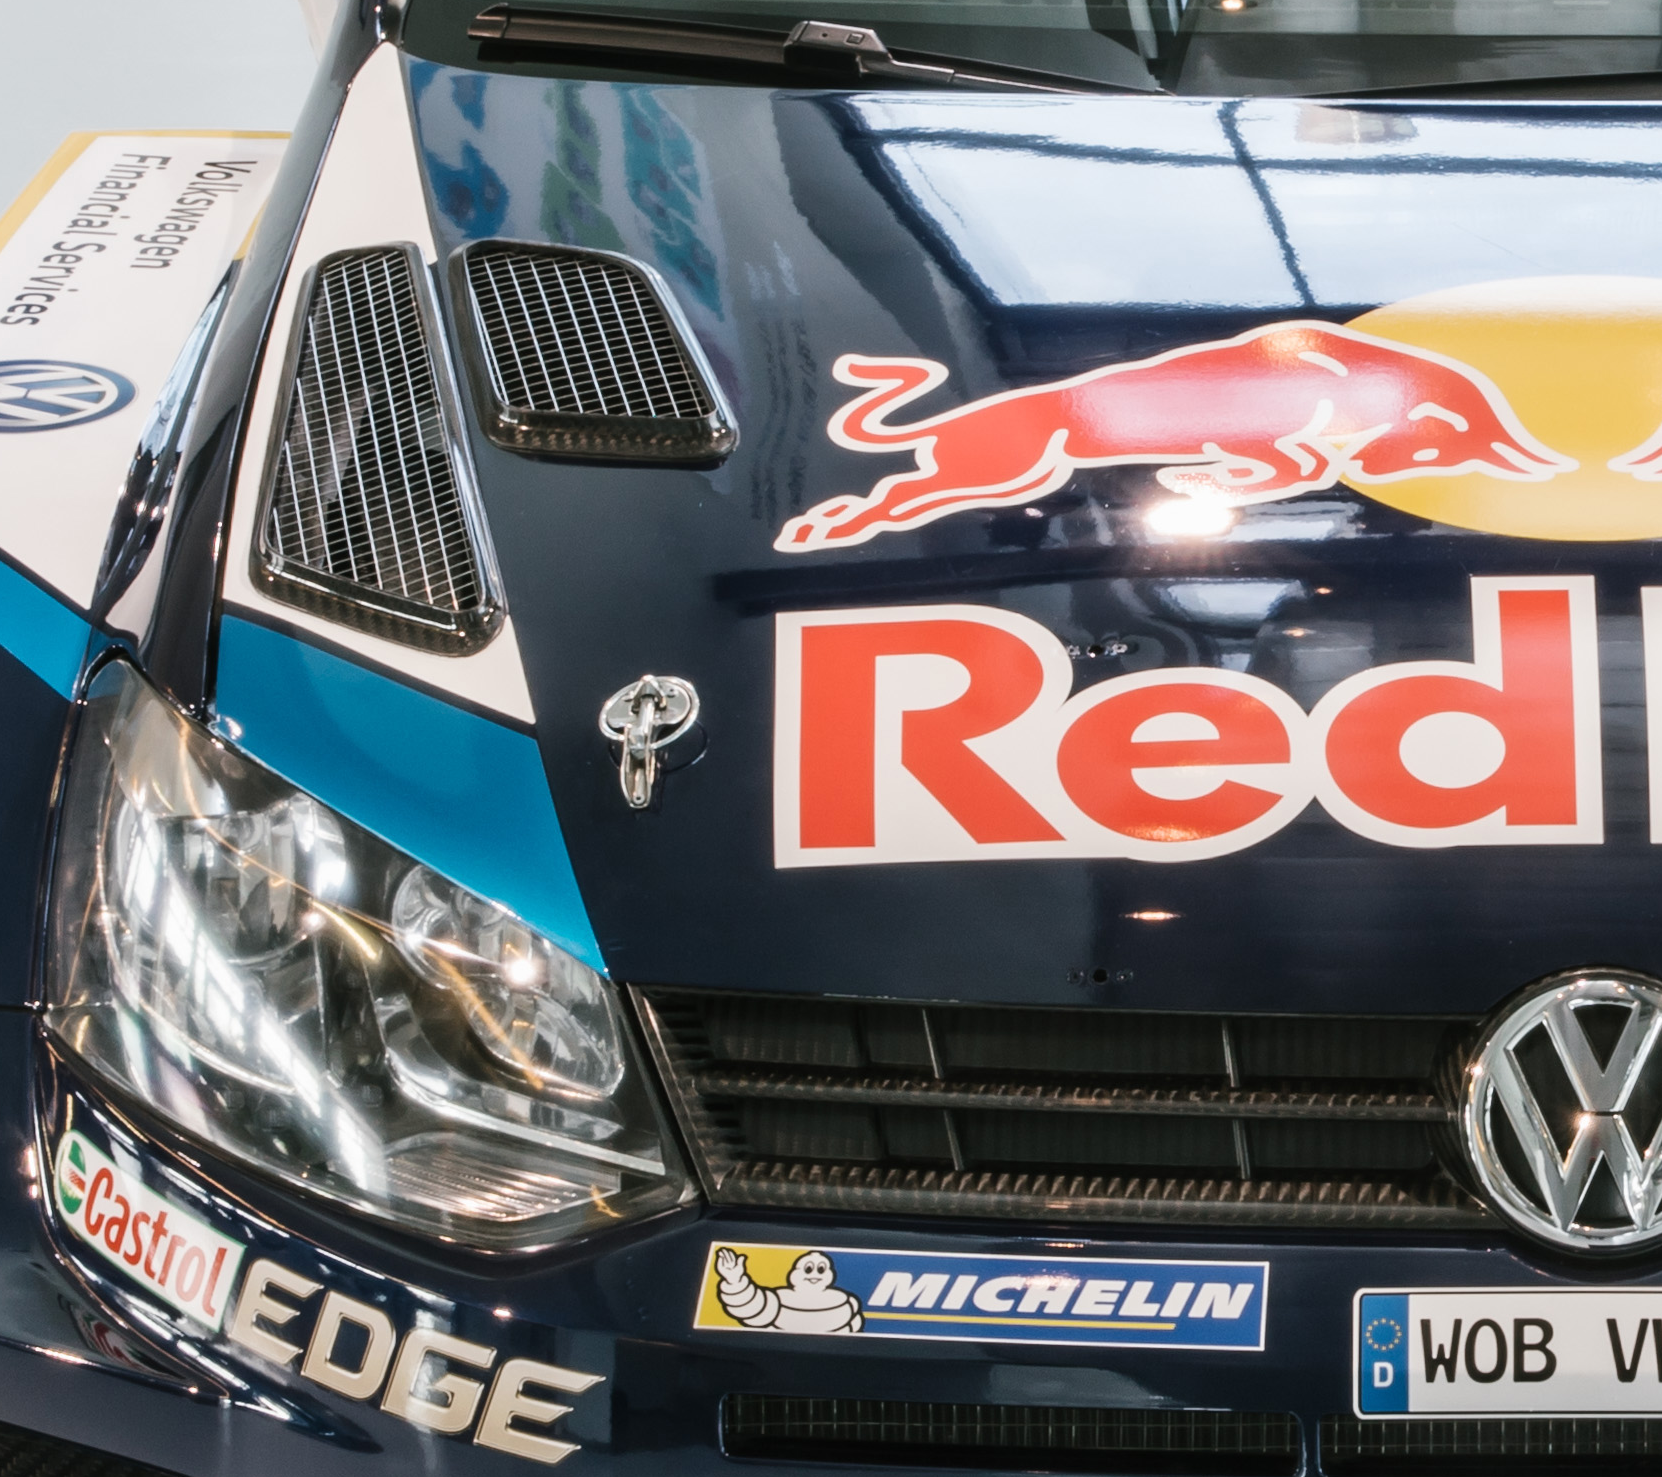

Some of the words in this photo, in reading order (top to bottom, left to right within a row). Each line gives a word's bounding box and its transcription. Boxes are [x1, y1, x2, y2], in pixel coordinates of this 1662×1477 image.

[63, 153, 172, 235] Financial
[130, 160, 258, 270] Volkswagen
[0, 240, 107, 326] Services
[788, 582, 1593, 857] Red
[80, 1161, 233, 1318] Castrol
[228, 1258, 606, 1465] EDGE
[869, 1271, 1257, 1321] MICHELIN
[1372, 1361, 1395, 1390] D
[1418, 1316, 1559, 1385] WOB
